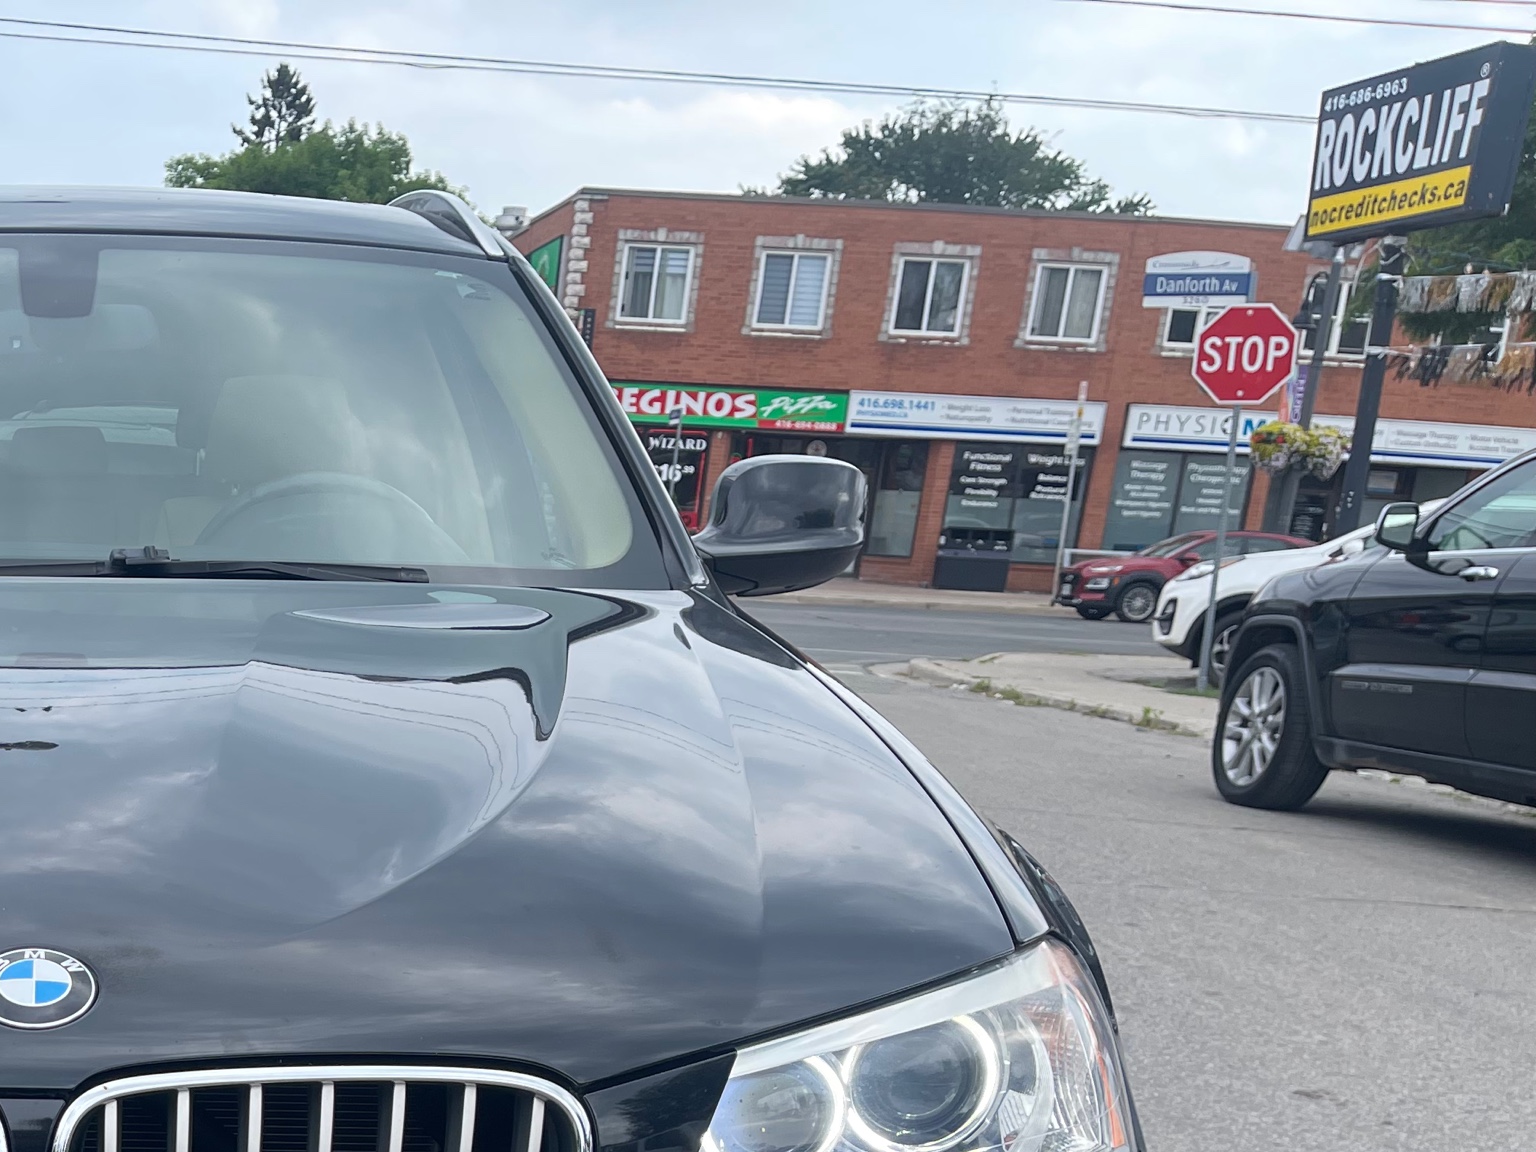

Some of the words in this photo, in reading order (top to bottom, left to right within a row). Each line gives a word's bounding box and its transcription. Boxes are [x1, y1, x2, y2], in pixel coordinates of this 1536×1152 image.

[1324, 77, 1408, 112] 416-686-6963
[1314, 78, 1491, 191] ROCKCLIFF
[1309, 179, 1466, 227] nocreditchecks.ca
[1156, 276, 1220, 293] Danforth
[1222, 279, 1239, 292] Av
[1200, 335, 1290, 373] STOP
[858, 397, 936, 410] 416.698.1441
[648, 434, 707, 451] WIZARD
